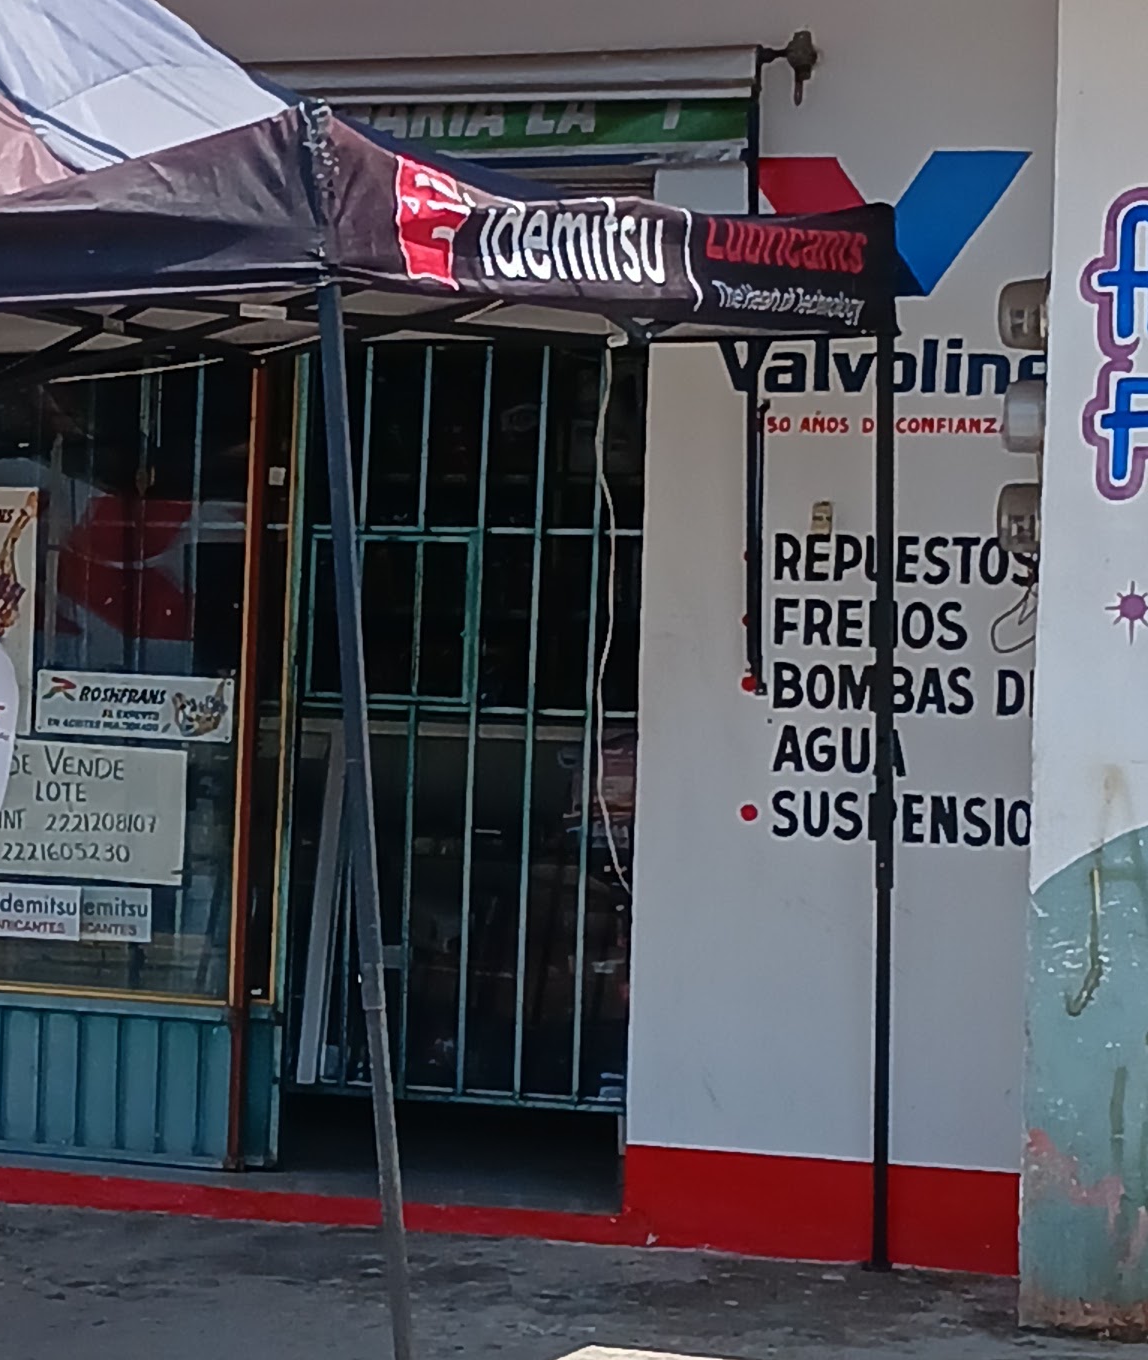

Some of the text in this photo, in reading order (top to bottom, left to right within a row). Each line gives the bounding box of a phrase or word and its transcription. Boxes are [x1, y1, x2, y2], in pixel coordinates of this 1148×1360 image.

[479, 198, 666, 285] idemitsu
[799, 411, 849, 434] AÑOS
[896, 417, 1004, 434] CONFIANZ
[79, 685, 167, 705] ROSHFRANS
[996, 669, 1034, 717] D
[44, 745, 125, 780] VENDE
[35, 779, 87, 802] LOTE
[1, 842, 130, 863] 2221605230
